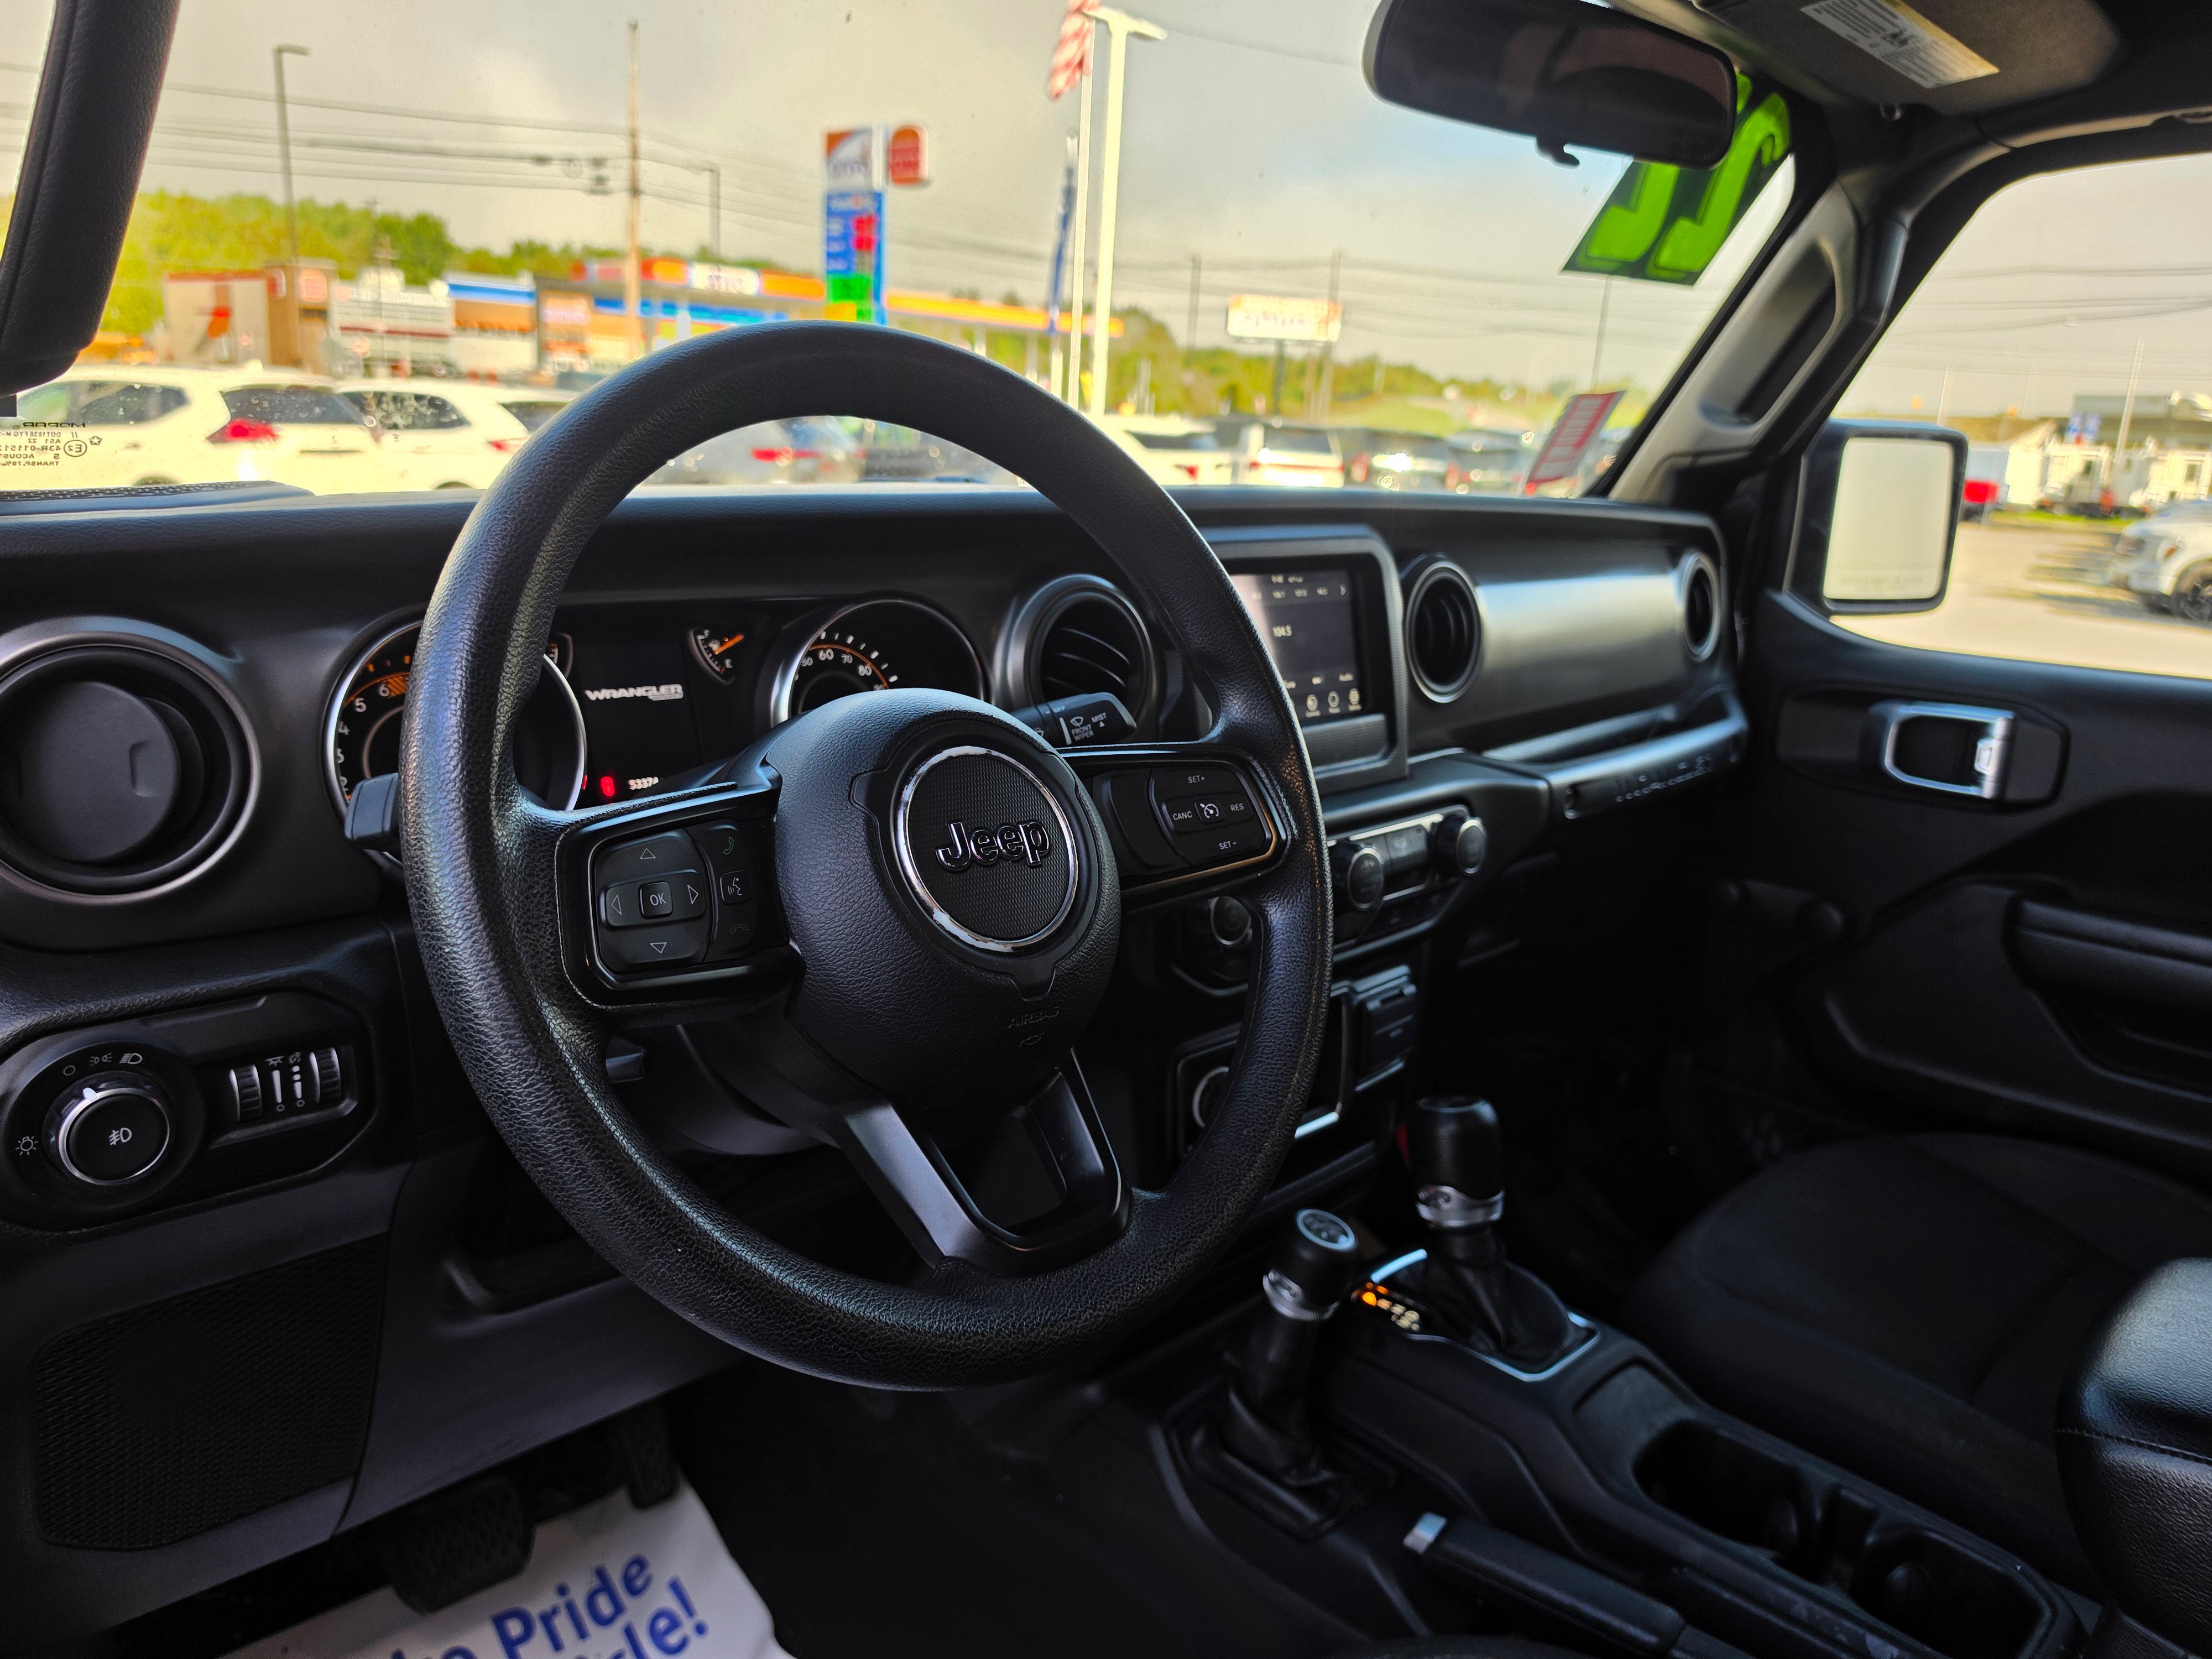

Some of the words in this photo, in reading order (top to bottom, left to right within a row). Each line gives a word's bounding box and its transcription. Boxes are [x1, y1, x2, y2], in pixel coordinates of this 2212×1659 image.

[818, 648, 834, 661] 60
[841, 653, 853, 664] 70
[858, 664, 872, 676] 80
[378, 683, 390, 697] 6
[585, 684, 684, 701] WRANGLER
[354, 697, 367, 712] 5
[1091, 712, 1107, 723] MIST
[1071, 723, 1092, 737] FRONT
[1074, 730, 1094, 742] WIPER
[1230, 803, 1244, 812] RES
[1172, 811, 1193, 821] CANC
[936, 821, 1050, 869] Jeep
[650, 893, 667, 906] OK
[491, 1553, 654, 1659] Pride
